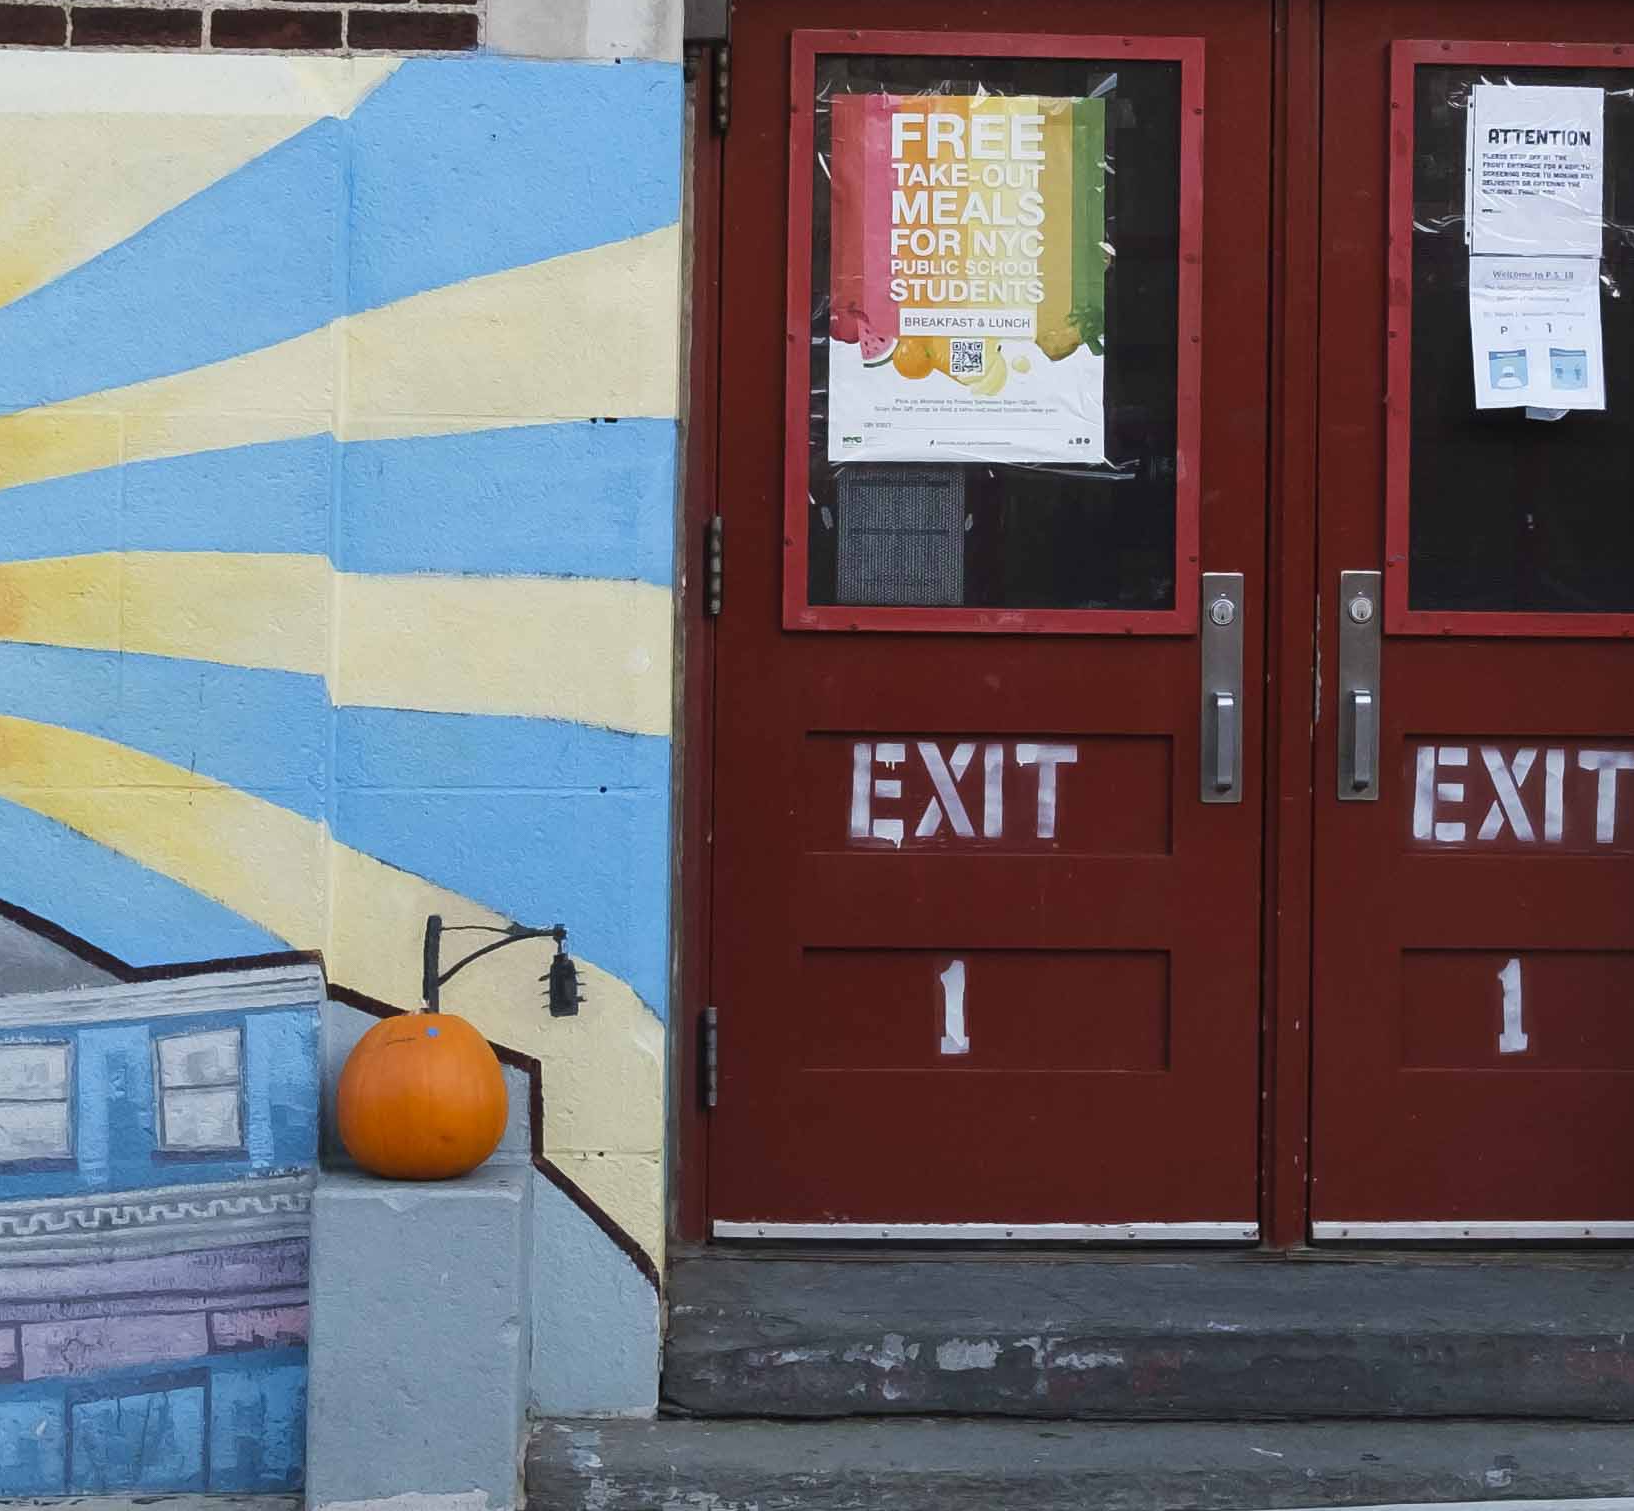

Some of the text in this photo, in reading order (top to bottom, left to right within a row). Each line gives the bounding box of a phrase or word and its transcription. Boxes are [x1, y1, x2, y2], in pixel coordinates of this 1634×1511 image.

[891, 112, 1046, 160] FREE
[1487, 128, 1592, 147] ATTENTION
[891, 163, 1045, 188] TAKE-OUT
[891, 190, 1046, 226] MEALS
[890, 228, 1045, 258] FOR NYC
[890, 259, 1044, 277] PUBLIC SCHOOL
[889, 278, 1046, 303] STUDENTS
[904, 316, 1031, 329] BREAKFAST & LUNCH
[847, 742, 1078, 846] EXIT
[938, 959, 970, 1055] 1
[1497, 958, 1529, 1054] 1
